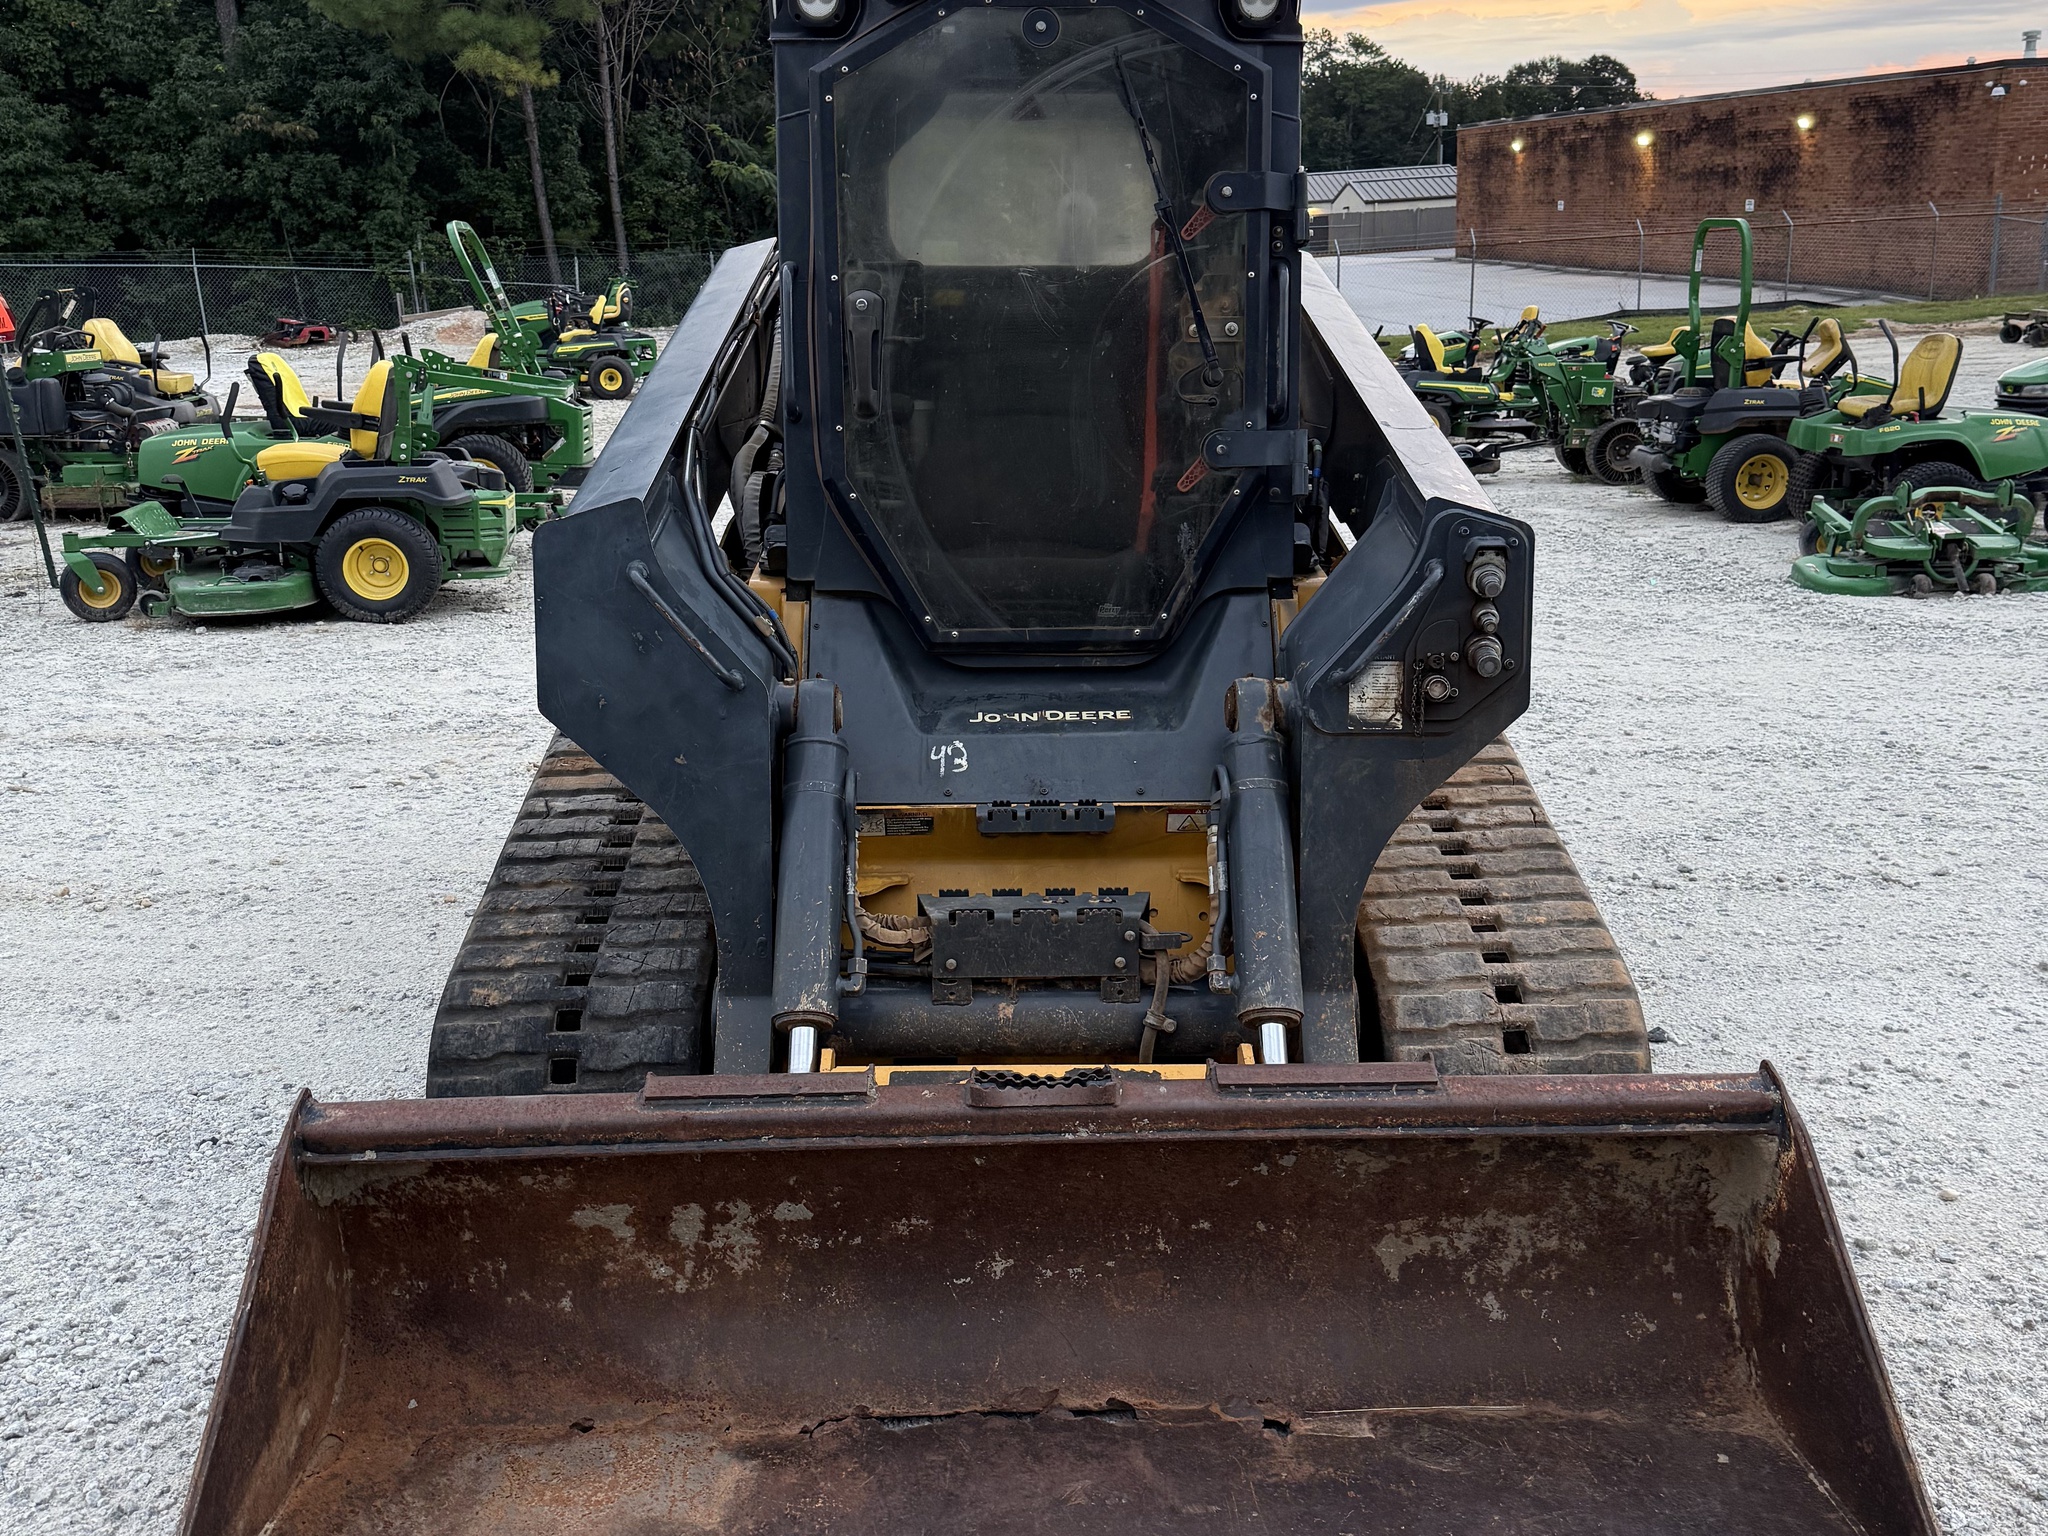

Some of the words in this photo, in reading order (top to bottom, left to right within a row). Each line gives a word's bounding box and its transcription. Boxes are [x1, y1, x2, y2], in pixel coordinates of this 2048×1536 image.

[1990, 418, 2013, 426] JOHN
[2015, 419, 2041, 427] DEERE
[171, 439, 198, 447] JOHN
[201, 437, 229, 445] DEER
[398, 475, 428, 483] ZTRAK
[1044, 709, 1133, 721] DEERE
[930, 740, 969, 778] 43
